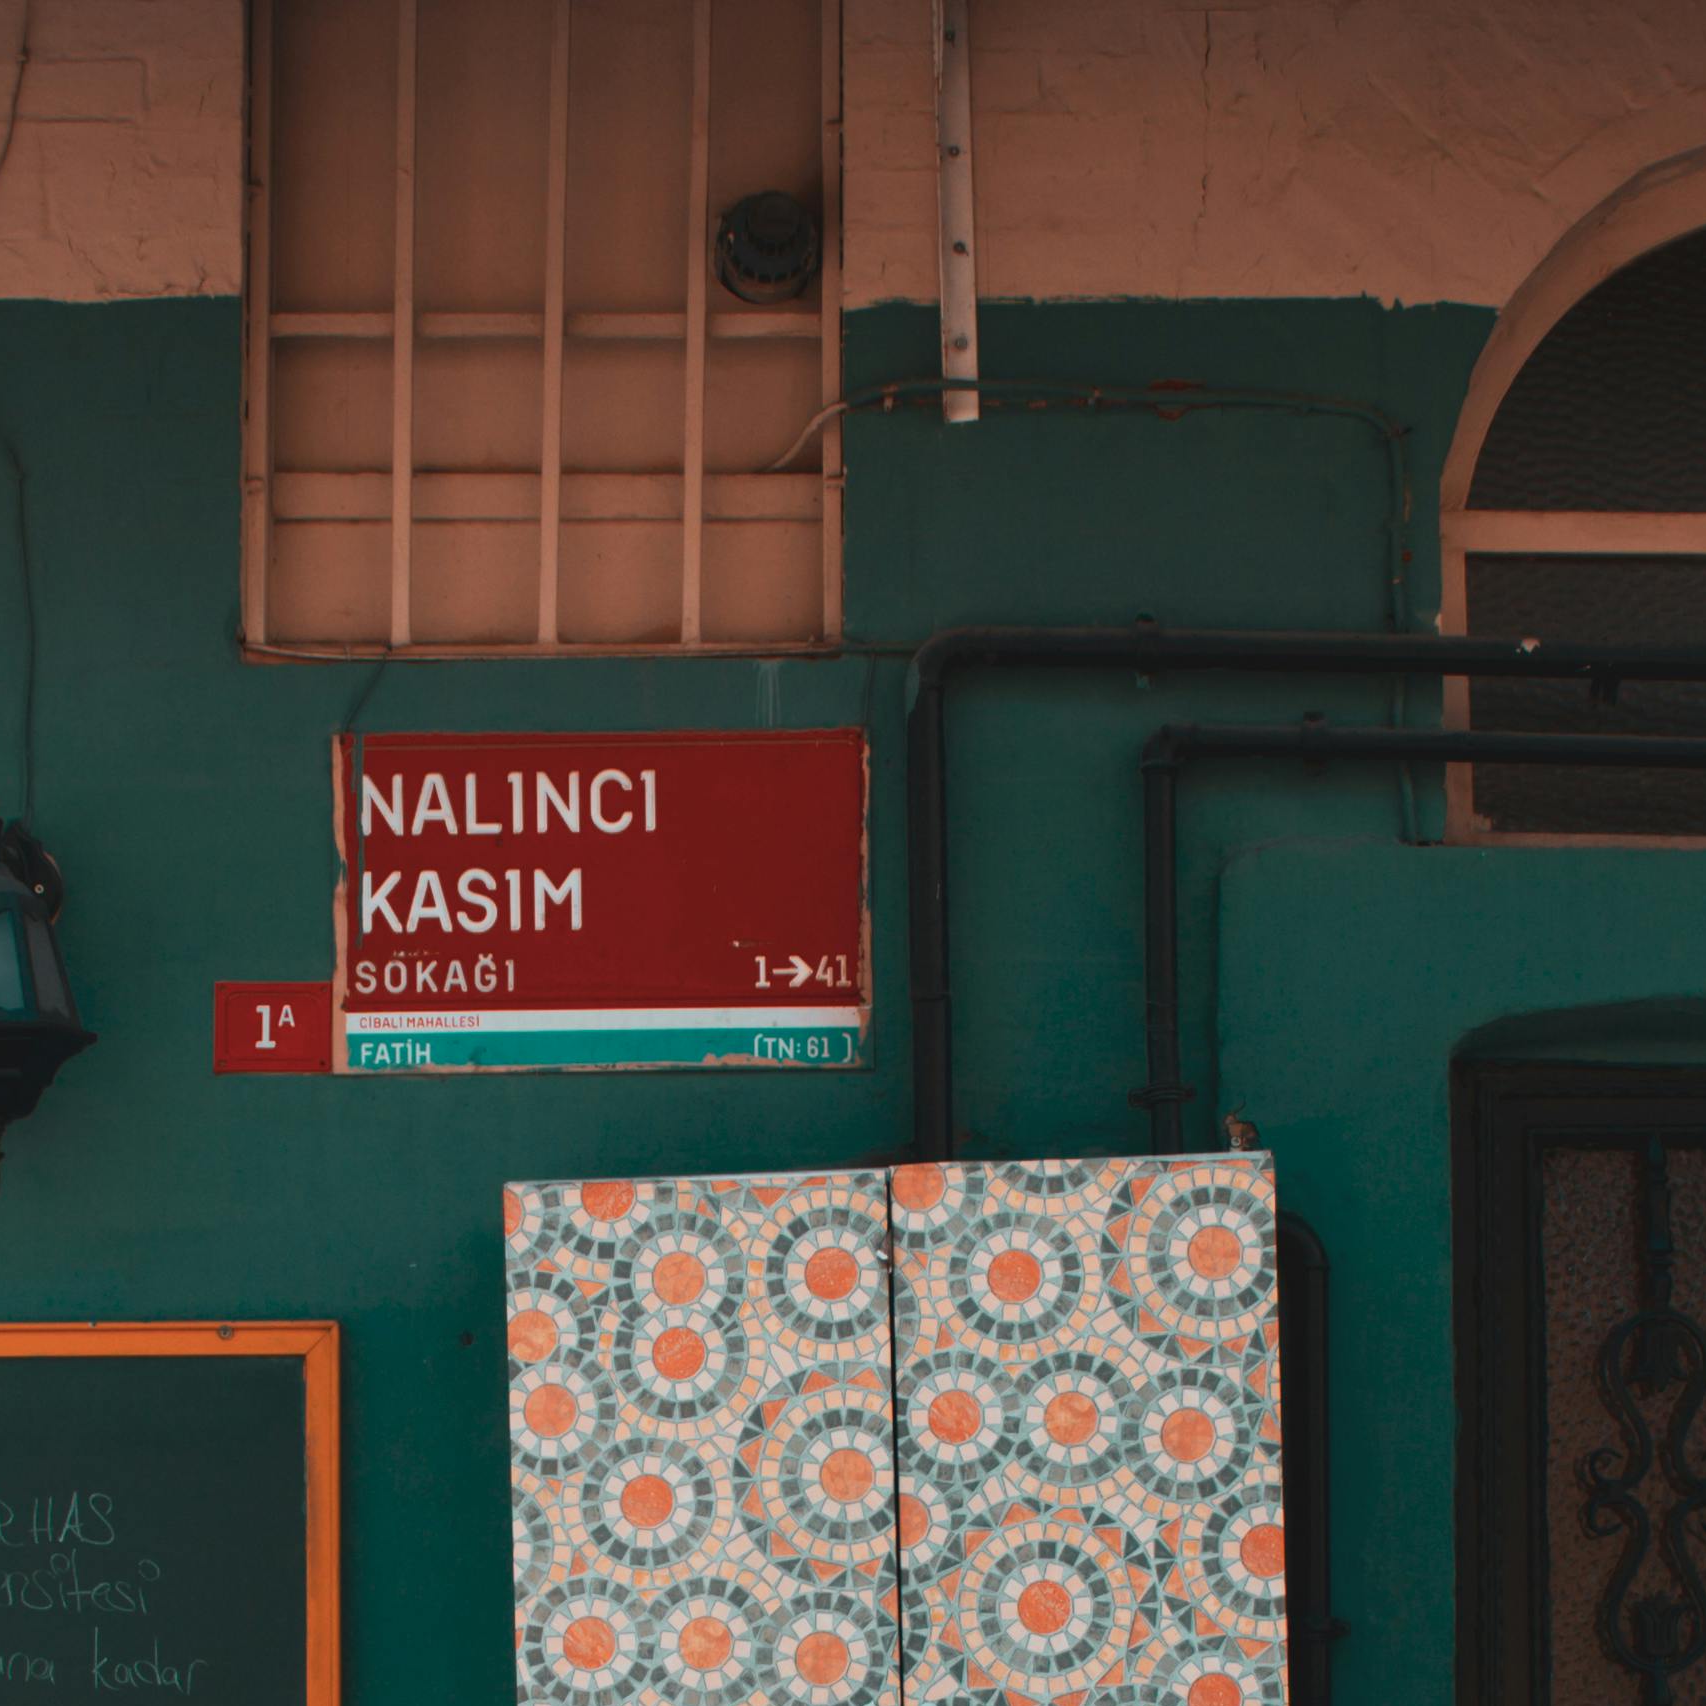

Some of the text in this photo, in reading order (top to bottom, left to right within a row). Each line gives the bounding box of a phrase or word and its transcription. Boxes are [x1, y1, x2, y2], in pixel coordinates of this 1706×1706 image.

[361, 769, 657, 837] NALINCI
[361, 867, 583, 934] KASIM
[354, 953, 516, 994] SOKAĞI
[360, 1038, 432, 1066] FATİH
